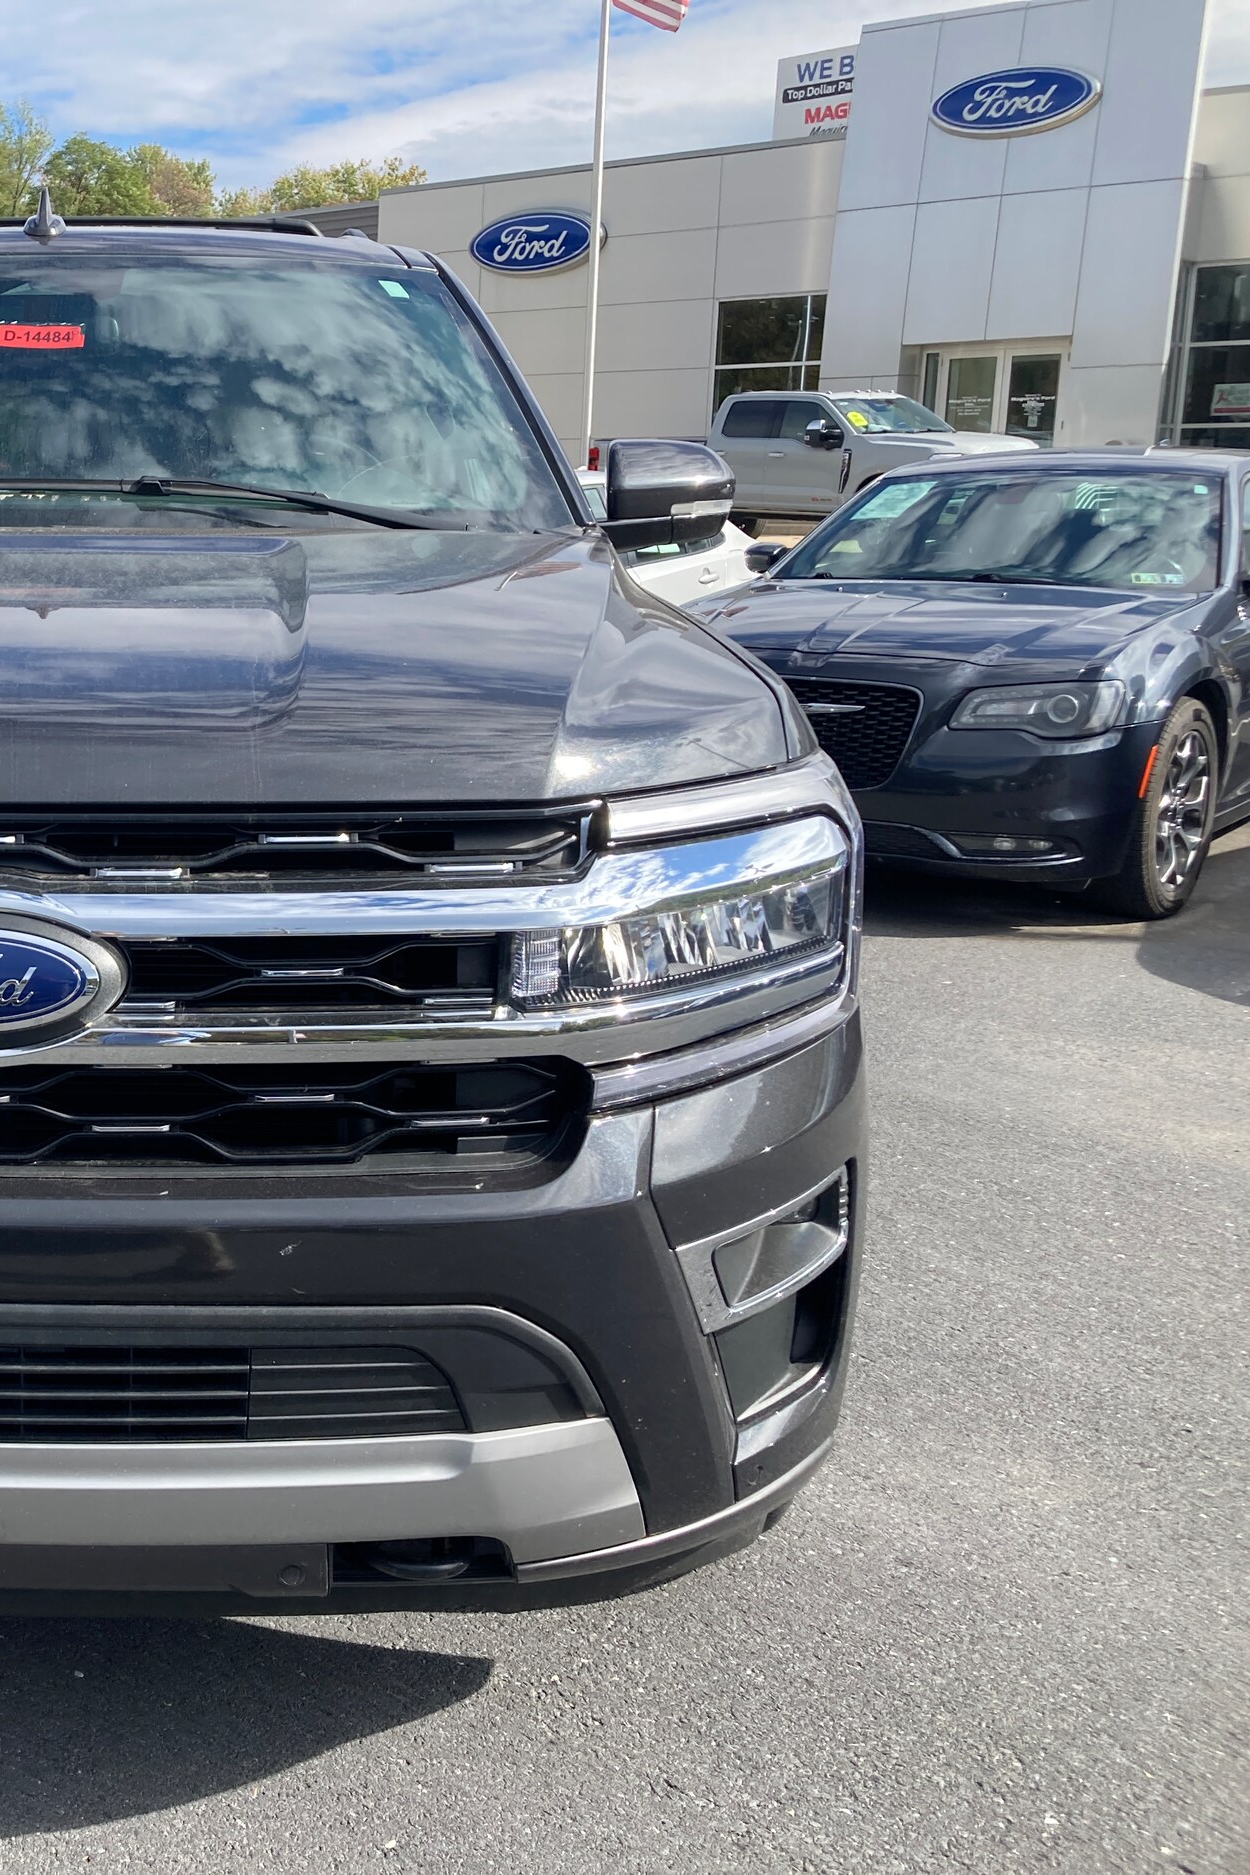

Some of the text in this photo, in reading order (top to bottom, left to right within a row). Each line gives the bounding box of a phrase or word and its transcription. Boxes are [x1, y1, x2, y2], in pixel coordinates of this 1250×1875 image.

[796, 58, 834, 83] WE
[786, 81, 853, 100] Top Dollar Pa
[962, 78, 1059, 122] Ford
[804, 102, 851, 125] MAG
[493, 224, 569, 263] Ford
